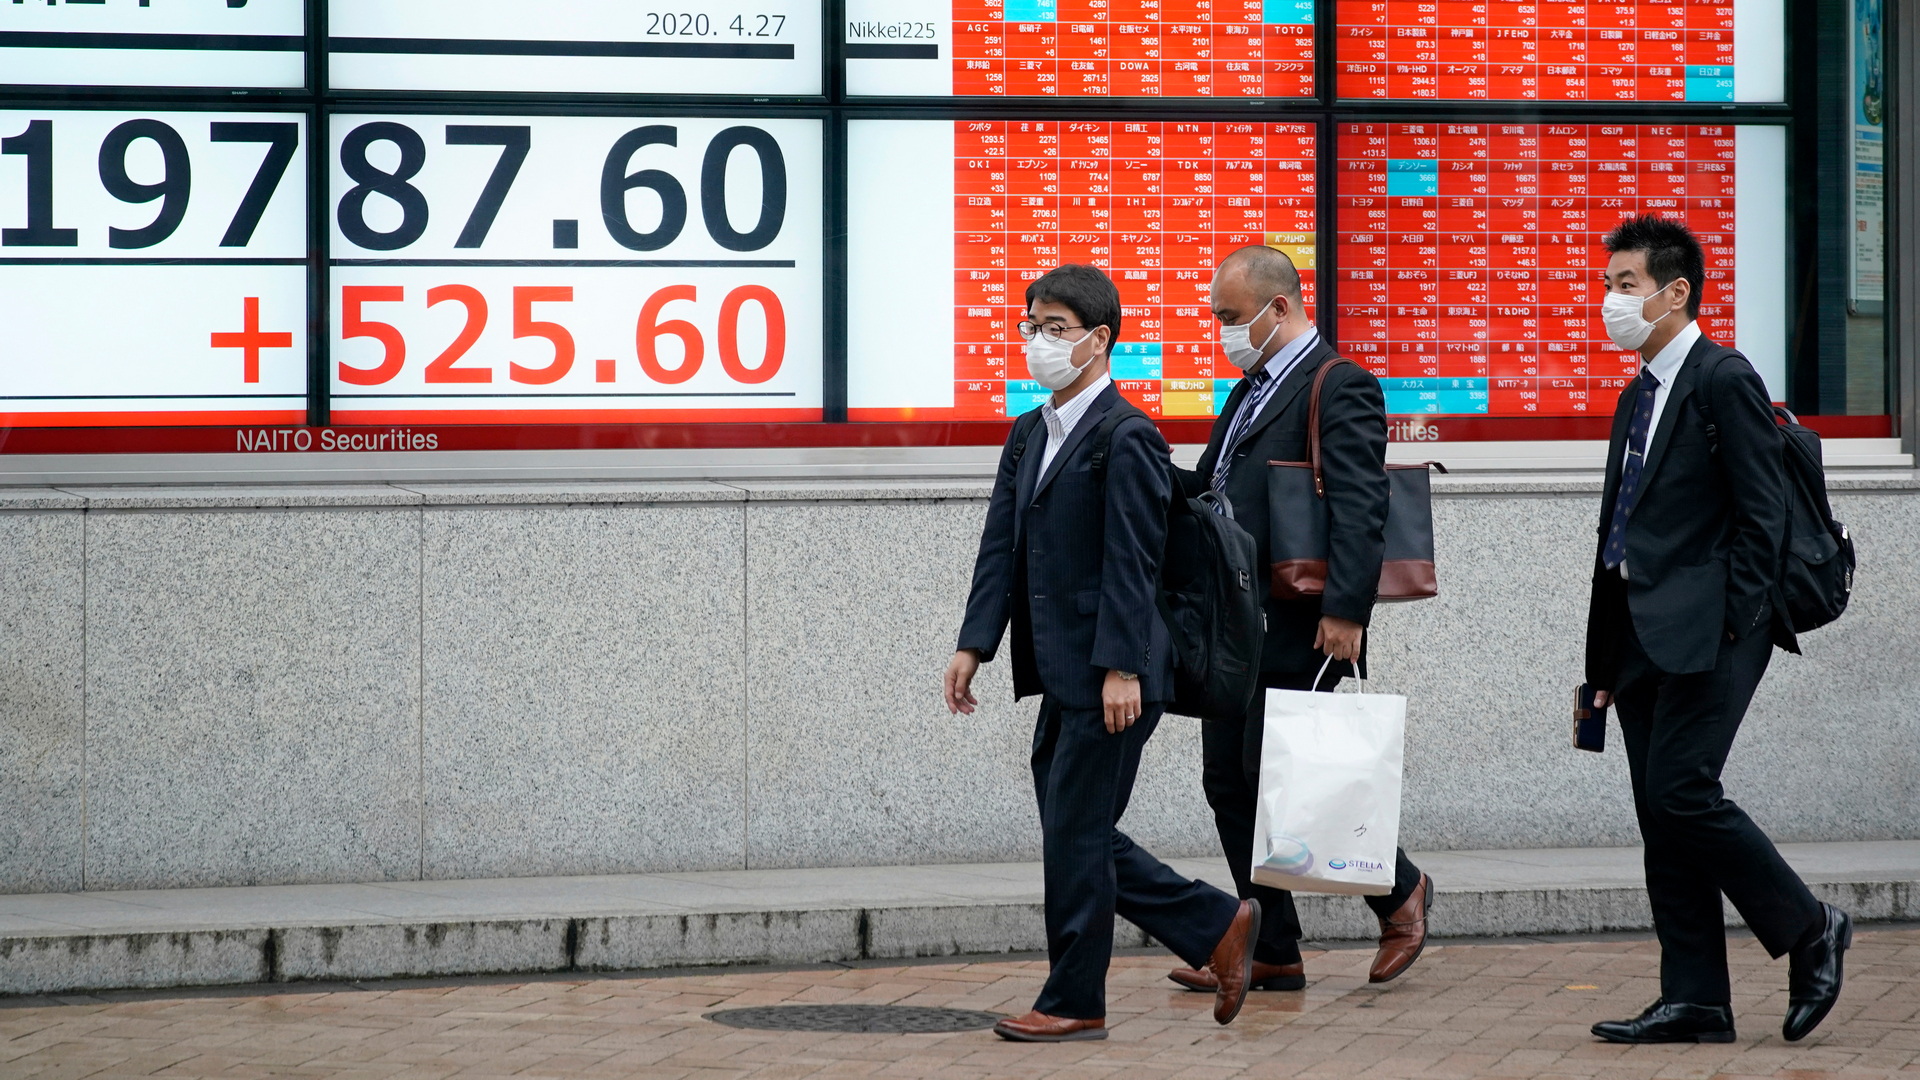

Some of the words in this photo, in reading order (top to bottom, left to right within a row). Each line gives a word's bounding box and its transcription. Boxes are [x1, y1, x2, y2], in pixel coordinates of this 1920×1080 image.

[1196, 1, 1210, 9] 416
[1472, 5, 1485, 13] 402
[1093, 12, 1106, 20] +37
[646, 13, 717, 36] 2020.
[729, 14, 786, 37] 4.27
[967, 24, 989, 32] AGC
[849, 22, 935, 39] Nikkei225
[1350, 28, 1373, 36] ガイシ
[985, 36, 1001, 44] 2591
[1090, 37, 1106, 45] 1461
[1192, 38, 1209, 46] 2101
[1368, 40, 1385, 48] 1332
[1472, 41, 1485, 49] 351
[1522, 42, 1535, 50] 702
[1568, 42, 1585, 50] 1718
[1618, 43, 1634, 51] 1270
[1093, 49, 1107, 57] +57
[1248, 50, 1261, 58] +14
[1120, 62, 1149, 70] DOWA
[1275, 63, 1304, 71] フジクラ
[1448, 66, 1477, 74] オークマ
[1501, 66, 1524, 74] アマダ
[1547, 67, 1577, 75] 日本郵政
[1601, 67, 1622, 75] コマツ
[985, 73, 1003, 81] 1258
[1037, 74, 1055, 82] 2230
[1083, 74, 1107, 82] 2671.5
[1238, 75, 1262, 83] 1078.0
[1300, 75, 1312, 83] 304
[1412, 77, 1435, 85] 2944.5
[1522, 78, 1535, 86] 935
[1612, 79, 1634, 87] 1970.0
[1141, 86, 1159, 94] +113
[1242, 87, 1262, 95] +24.0
[1299, 87, 1312, 95] +21
[1468, 89, 1486, 97] +170
[1069, 124, 1100, 132] ダイキン
[1125, 124, 1148, 132] 日精工
[1548, 127, 1577, 135] オムロン
[1651, 127, 1672, 135] NEC
[981, 135, 1004, 143] 1293.5
[1087, 136, 1109, 144] 13465
[1147, 136, 1160, 144] 709
[1199, 136, 1212, 144] 197
[1297, 137, 1314, 145] 1677
[1369, 137, 1385, 145] 3041
[1469, 138, 1486, 146] 2476
[1017, 161, 1048, 169] エプソン
[1125, 161, 1148, 169] ソニー
[1399, 162, 1426, 170] デンソー
[1552, 163, 1574, 171] 京セラ
[1039, 173, 1057, 181] 1109
[1, 118, 786, 251] 19787.60
[1127, 198, 1146, 206] IHI
[1352, 198, 1373, 206] トヨタ
[1502, 199, 1524, 207] マツダ
[1551, 199, 1574, 207] ホンダ
[1601, 199, 1623, 207] スズキ
[1646, 199, 1677, 207] SUBARU
[1032, 210, 1057, 218] 2706.0
[1143, 210, 1160, 218] 1273
[1198, 210, 1211, 218] 321
[1295, 210, 1314, 218] 752.4
[1473, 210, 1486, 218] 294
[968, 235, 992, 243] ニコン
[1401, 235, 1424, 243] 大日印
[1452, 235, 1474, 243] ヤマハ
[991, 246, 1004, 254] 974
[1033, 246, 1056, 254] 1735.5
[1136, 247, 1160, 255] 2210.5
[1469, 247, 1486, 255] 4225
[1513, 247, 1536, 255] 2157.0
[982, 284, 1004, 292] 21865
[1369, 283, 1386, 291] 1334
[1419, 283, 1436, 291] 1917
[1467, 283, 1486, 291] 422.2
[1569, 283, 1586, 291] 3149
[987, 296, 1004, 304] +555
[1552, 308, 1574, 316] 三井不
[1140, 320, 1160, 328] 432.0
[1198, 320, 1211, 328] 797
[1413, 319, 1436, 327] 1320.5
[1523, 319, 1536, 327] 892
[1140, 332, 1160, 340] +10.2
[1194, 357, 1211, 365] 3115
[1419, 355, 1436, 363] 5070
[1520, 355, 1536, 363] 1434
[1402, 380, 1424, 388] 大ガス
[990, 395, 1004, 403] 402
[1143, 394, 1160, 402] 3287
[1520, 391, 1536, 399] 1049
[1569, 391, 1586, 399] 9132
[1387, 421, 1439, 441] rities
[237, 430, 312, 451] NAITO
[321, 429, 438, 450] Securities
[1348, 860, 1383, 870] STELLA
